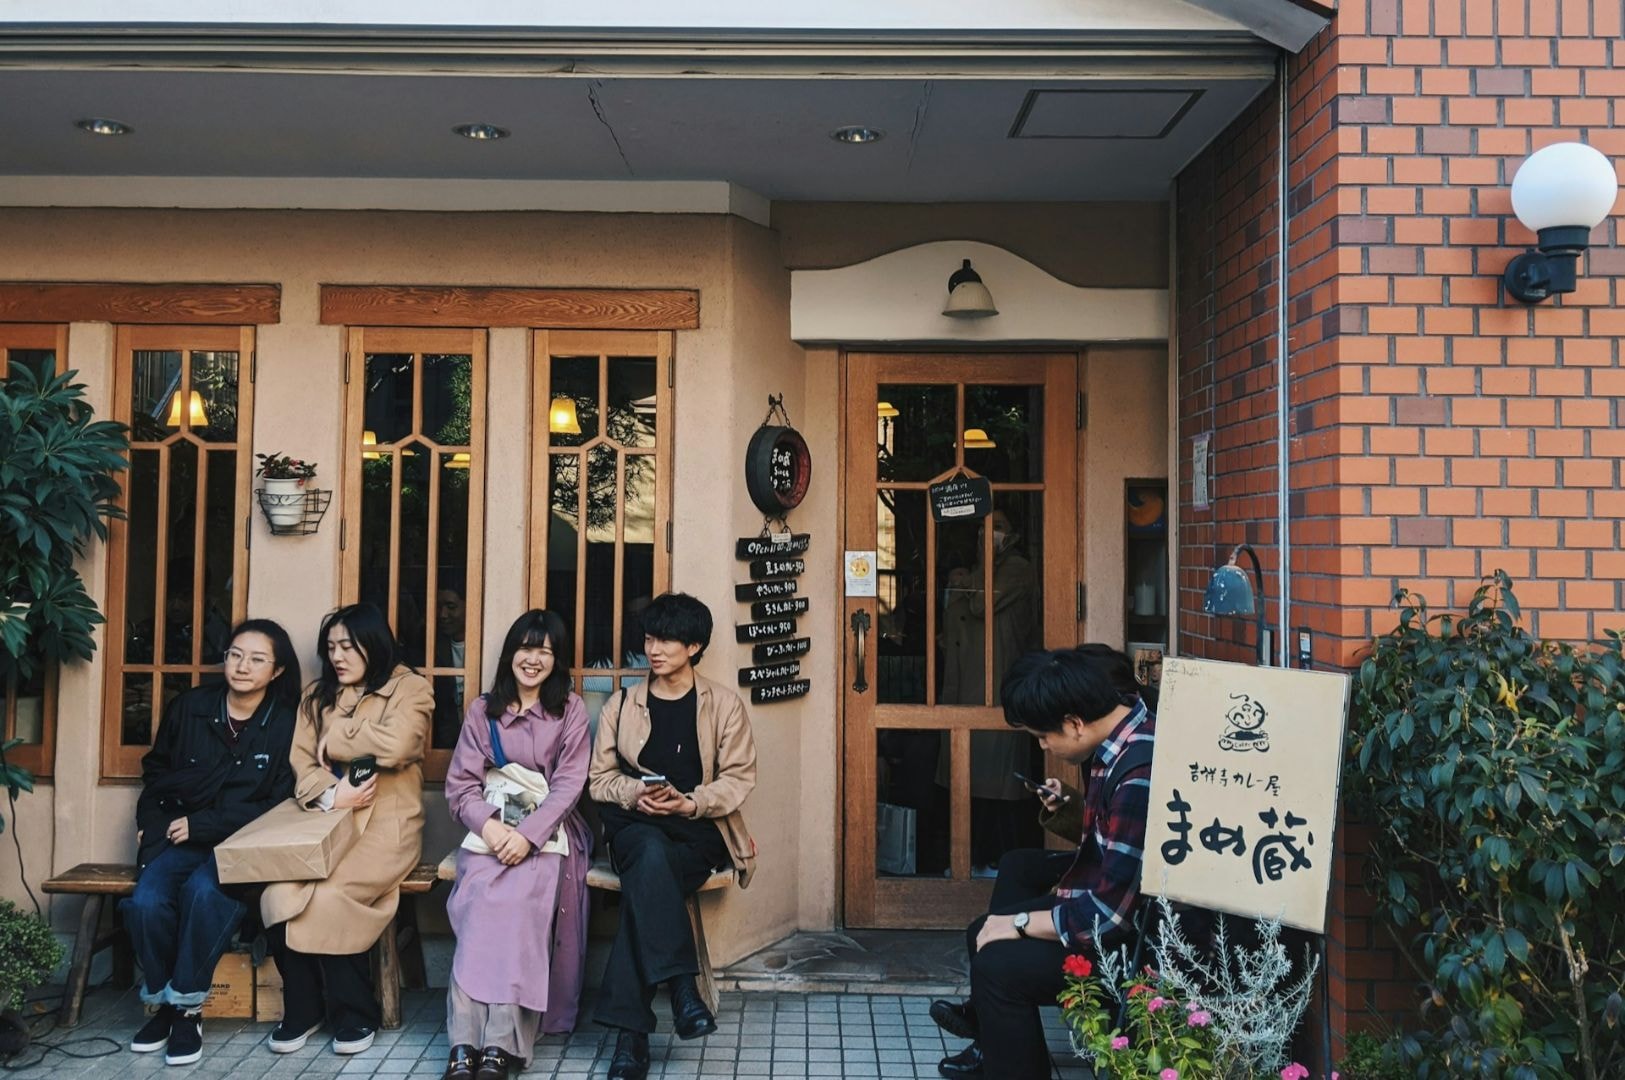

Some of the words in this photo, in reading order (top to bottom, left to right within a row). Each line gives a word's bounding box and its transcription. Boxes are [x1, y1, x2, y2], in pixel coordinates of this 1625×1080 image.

[1188, 761, 1282, 797] 吉祥寺カレー屋
[1160, 788, 1315, 885] まめ蔵
